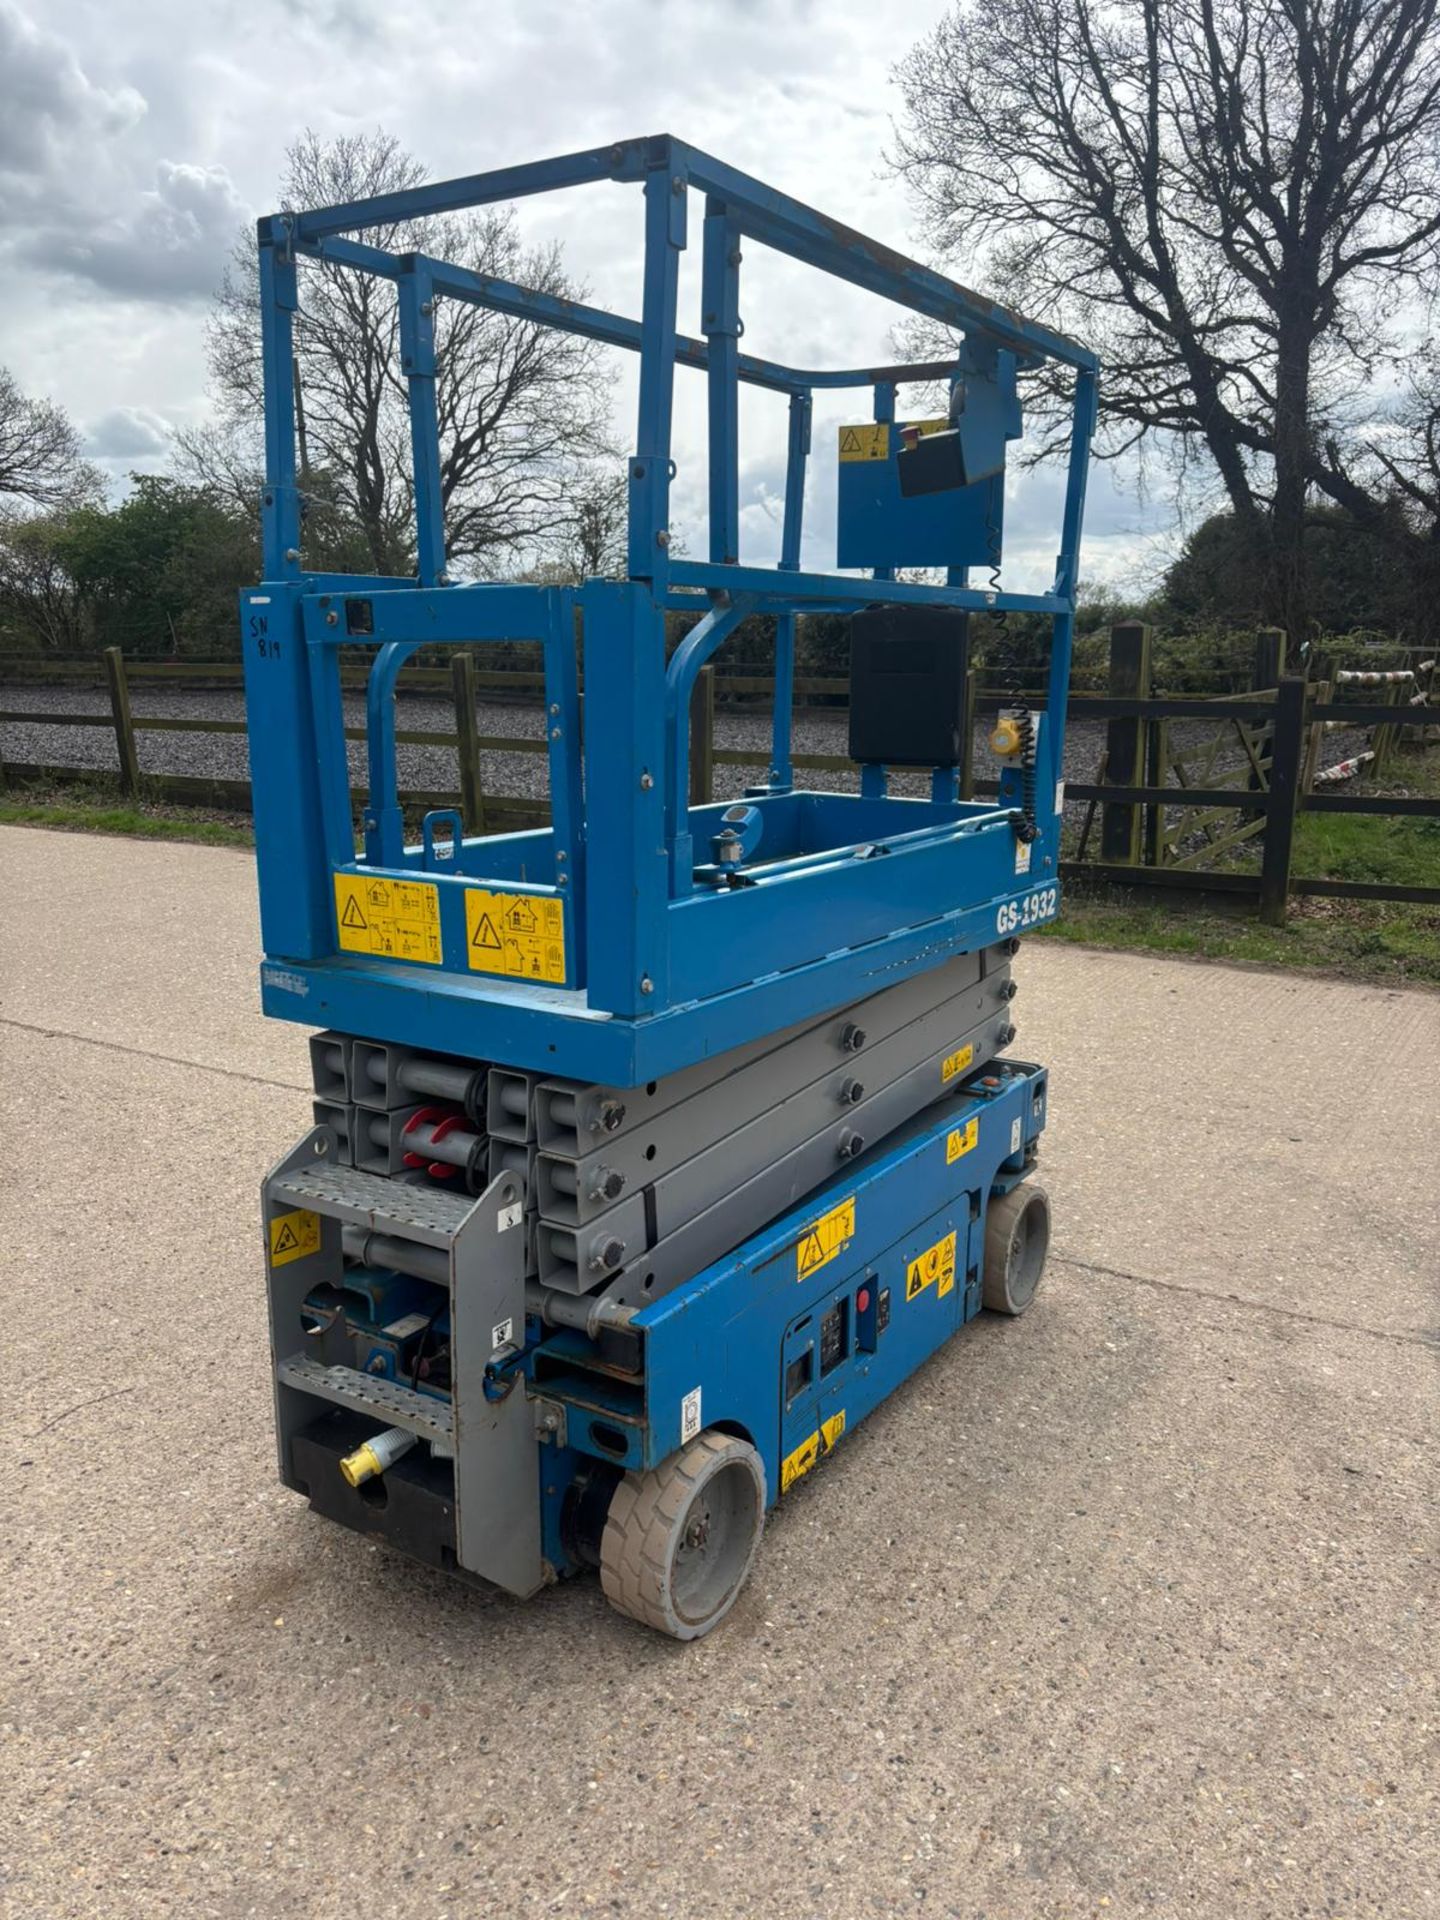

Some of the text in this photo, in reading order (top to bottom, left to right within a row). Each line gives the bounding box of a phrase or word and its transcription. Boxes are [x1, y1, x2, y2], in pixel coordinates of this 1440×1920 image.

[249, 616, 268, 638] SN
[258, 639, 281, 660] 819
[997, 888, 1056, 934] GS-1932
